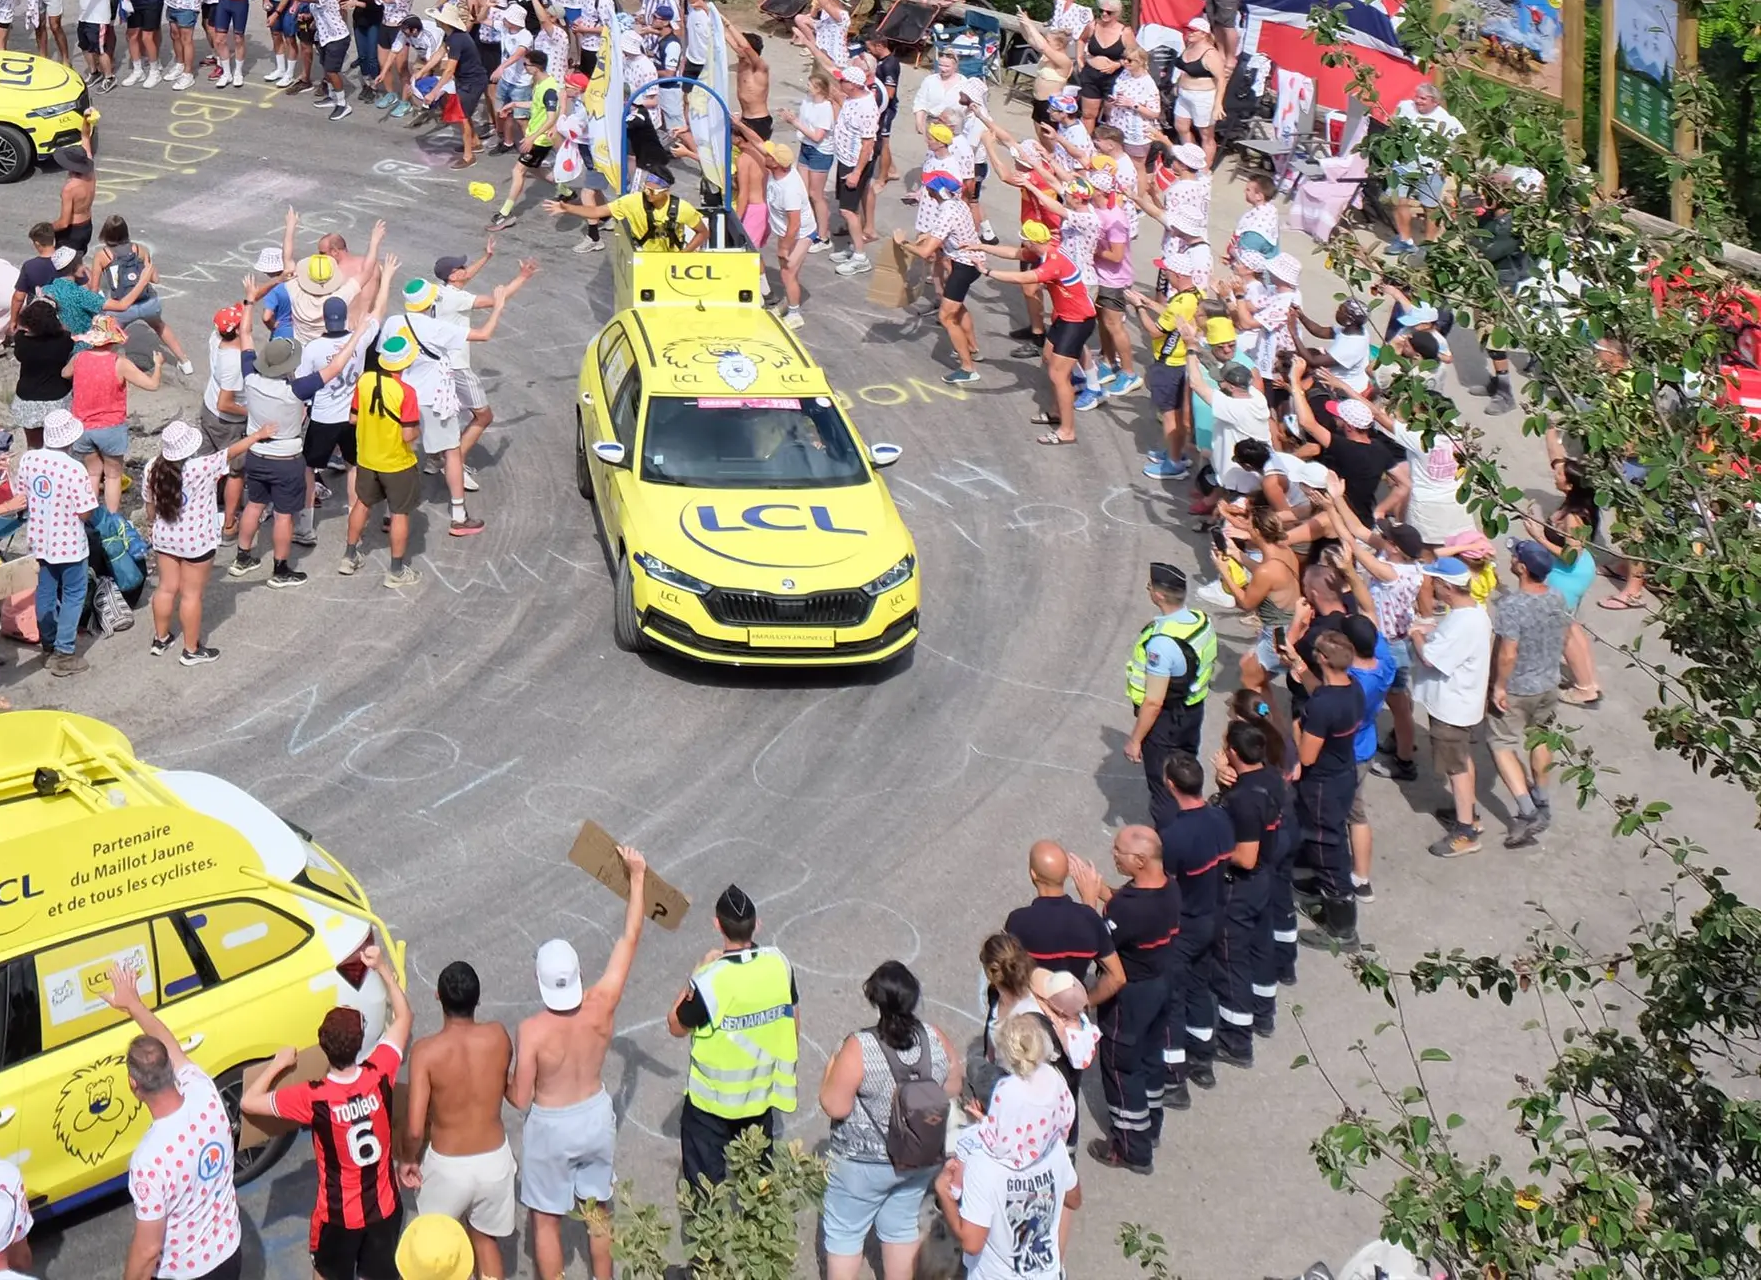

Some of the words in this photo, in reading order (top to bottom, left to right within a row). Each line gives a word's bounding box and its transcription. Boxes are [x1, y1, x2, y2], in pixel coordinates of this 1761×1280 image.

[670, 264, 722, 281] LCL
[673, 373, 704, 383] LCL
[780, 373, 810, 383] LCL
[696, 504, 868, 536] LCL
[660, 590, 682, 606] LCL
[890, 594, 907, 607] LCL
[92, 824, 172, 858] Partenaire
[70, 870, 90, 888] du
[93, 856, 148, 881] Maillot
[150, 840, 195, 865] Jaune
[48, 902, 63, 918] et
[67, 896, 87, 913] de
[89, 885, 124, 905] tous
[126, 875, 148, 894] les
[150, 856, 218, 888] cyclistes.
[345, 1120, 382, 1167] 6
